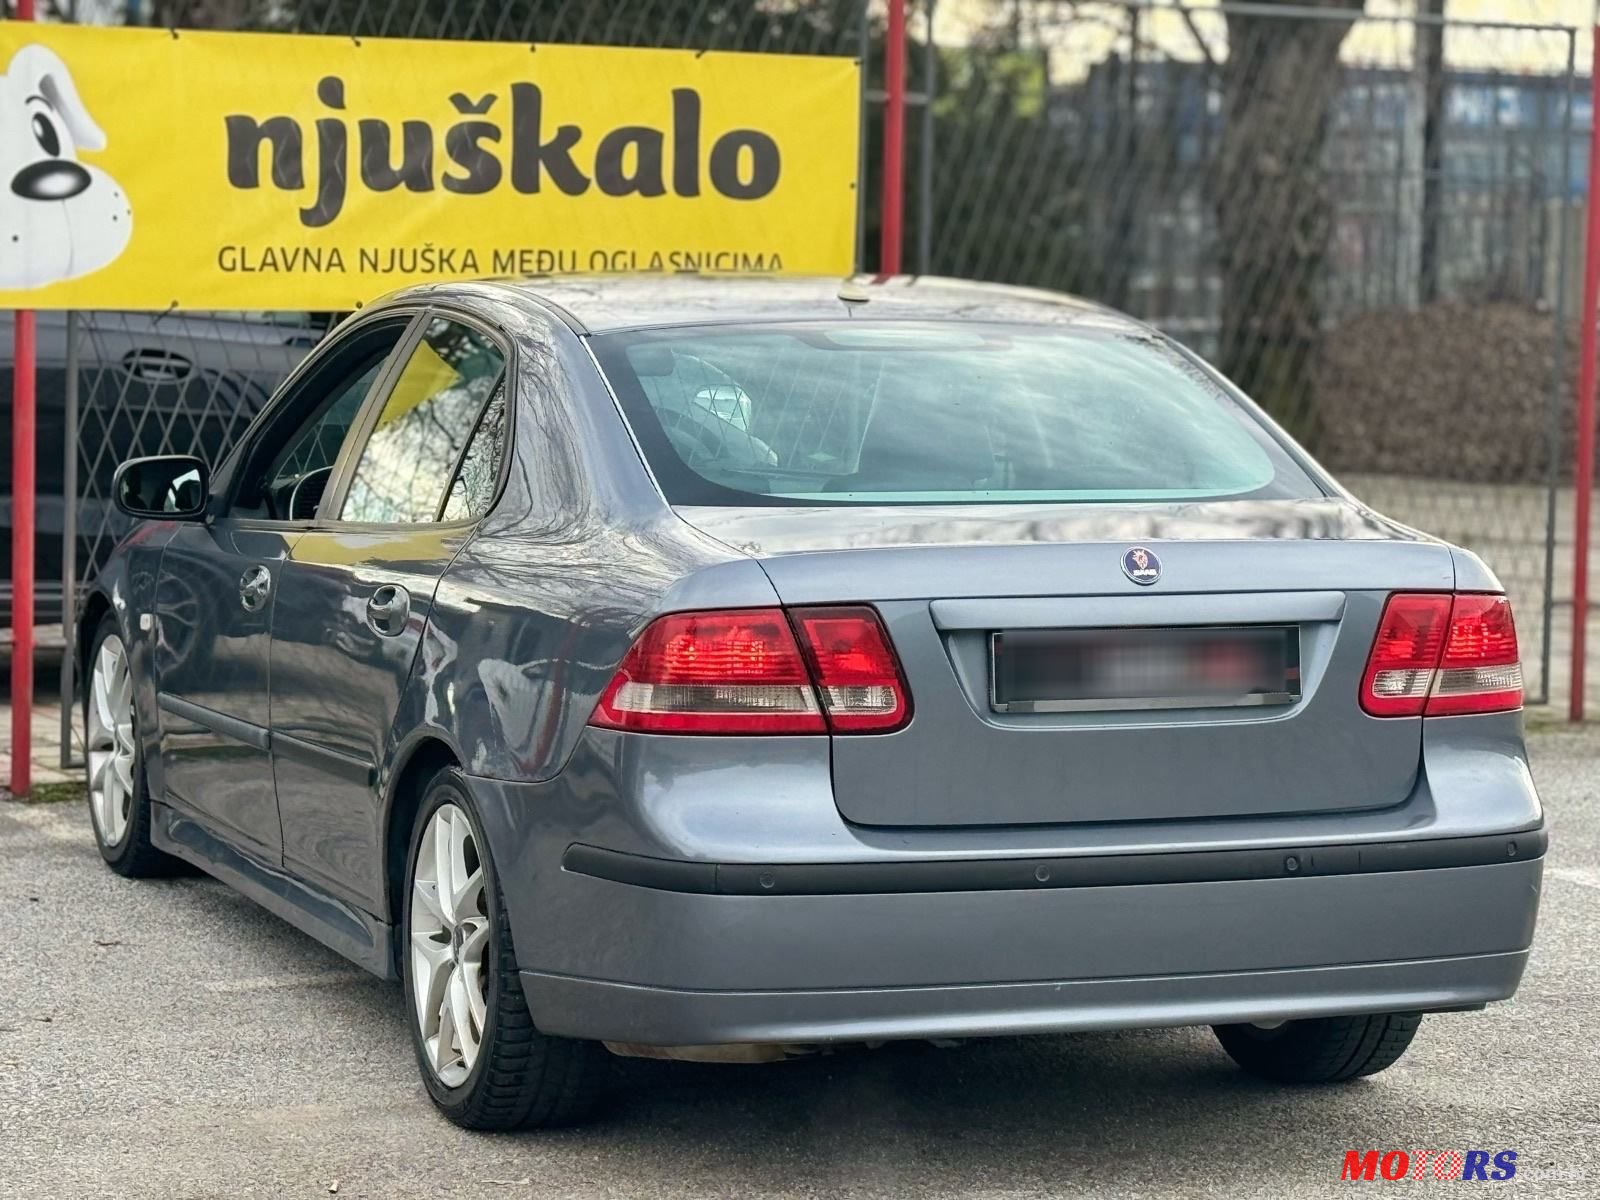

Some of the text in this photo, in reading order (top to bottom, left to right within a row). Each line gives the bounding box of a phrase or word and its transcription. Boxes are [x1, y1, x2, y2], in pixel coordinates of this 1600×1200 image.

[224, 76, 781, 227] njuškalo
[218, 246, 346, 273] GLAVNA
[359, 243, 480, 274] NJUŠKA
[493, 249, 576, 273] MEĐU
